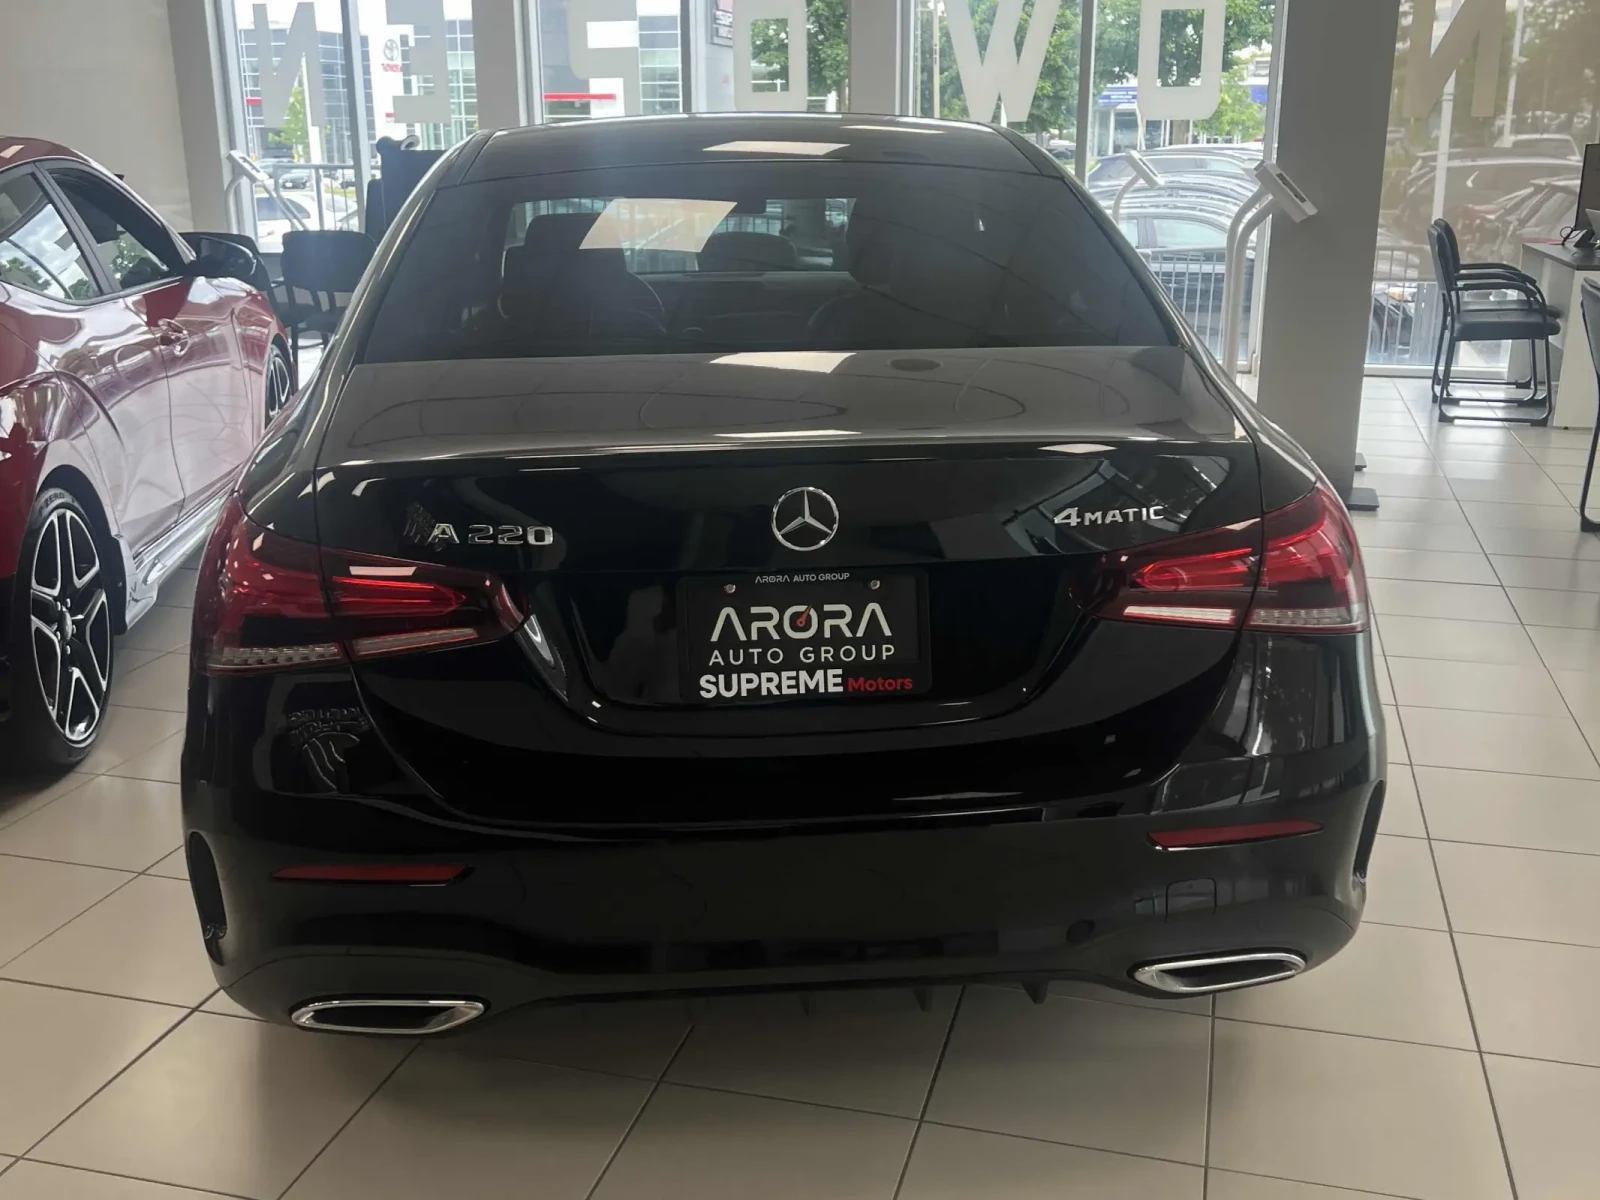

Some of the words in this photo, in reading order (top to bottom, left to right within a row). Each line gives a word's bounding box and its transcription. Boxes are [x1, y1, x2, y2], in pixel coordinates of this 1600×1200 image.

[1053, 505, 1165, 526] 4MATIC
[426, 523, 460, 546] A
[468, 524, 554, 545] 220
[754, 575, 790, 584] ARORA
[793, 573, 817, 582] AUTO
[818, 572, 850, 581] GROUP
[710, 602, 893, 642] ARORA
[708, 648, 784, 666] AUTO
[799, 644, 895, 664] GROUP
[699, 668, 844, 699] SUPREME
[848, 677, 913, 692] Motors
